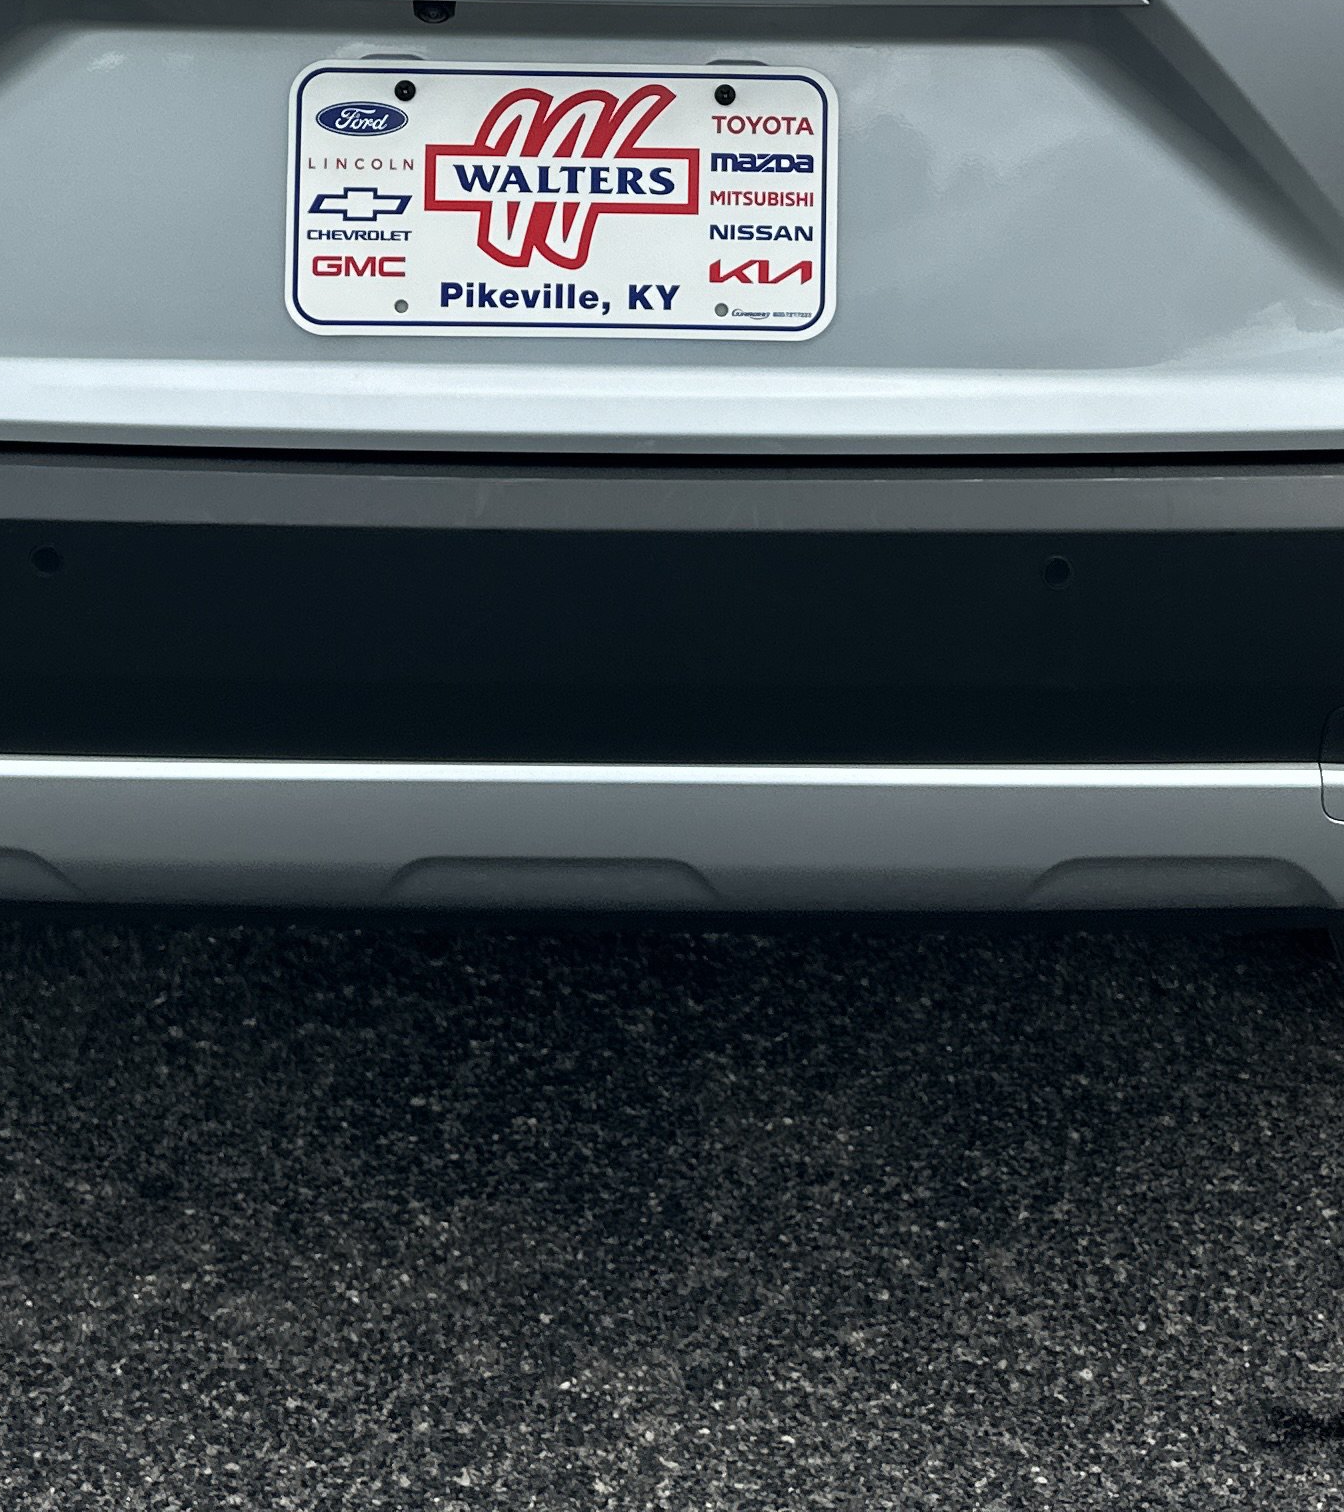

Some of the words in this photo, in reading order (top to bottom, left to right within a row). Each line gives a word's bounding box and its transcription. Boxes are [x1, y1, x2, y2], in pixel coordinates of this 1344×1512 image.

[334, 107, 389, 131] Ford
[711, 115, 815, 136] TOYOTA
[307, 157, 415, 171] LINCOLN
[452, 164, 676, 195] WALTERS
[709, 190, 815, 208] MITSUBISHI
[306, 229, 413, 242] CHEVROLET
[709, 224, 814, 242] NISSAN
[312, 255, 407, 278] GMC
[709, 258, 814, 285] KIA
[440, 281, 611, 315] Pikeville,
[628, 284, 681, 311] KY
